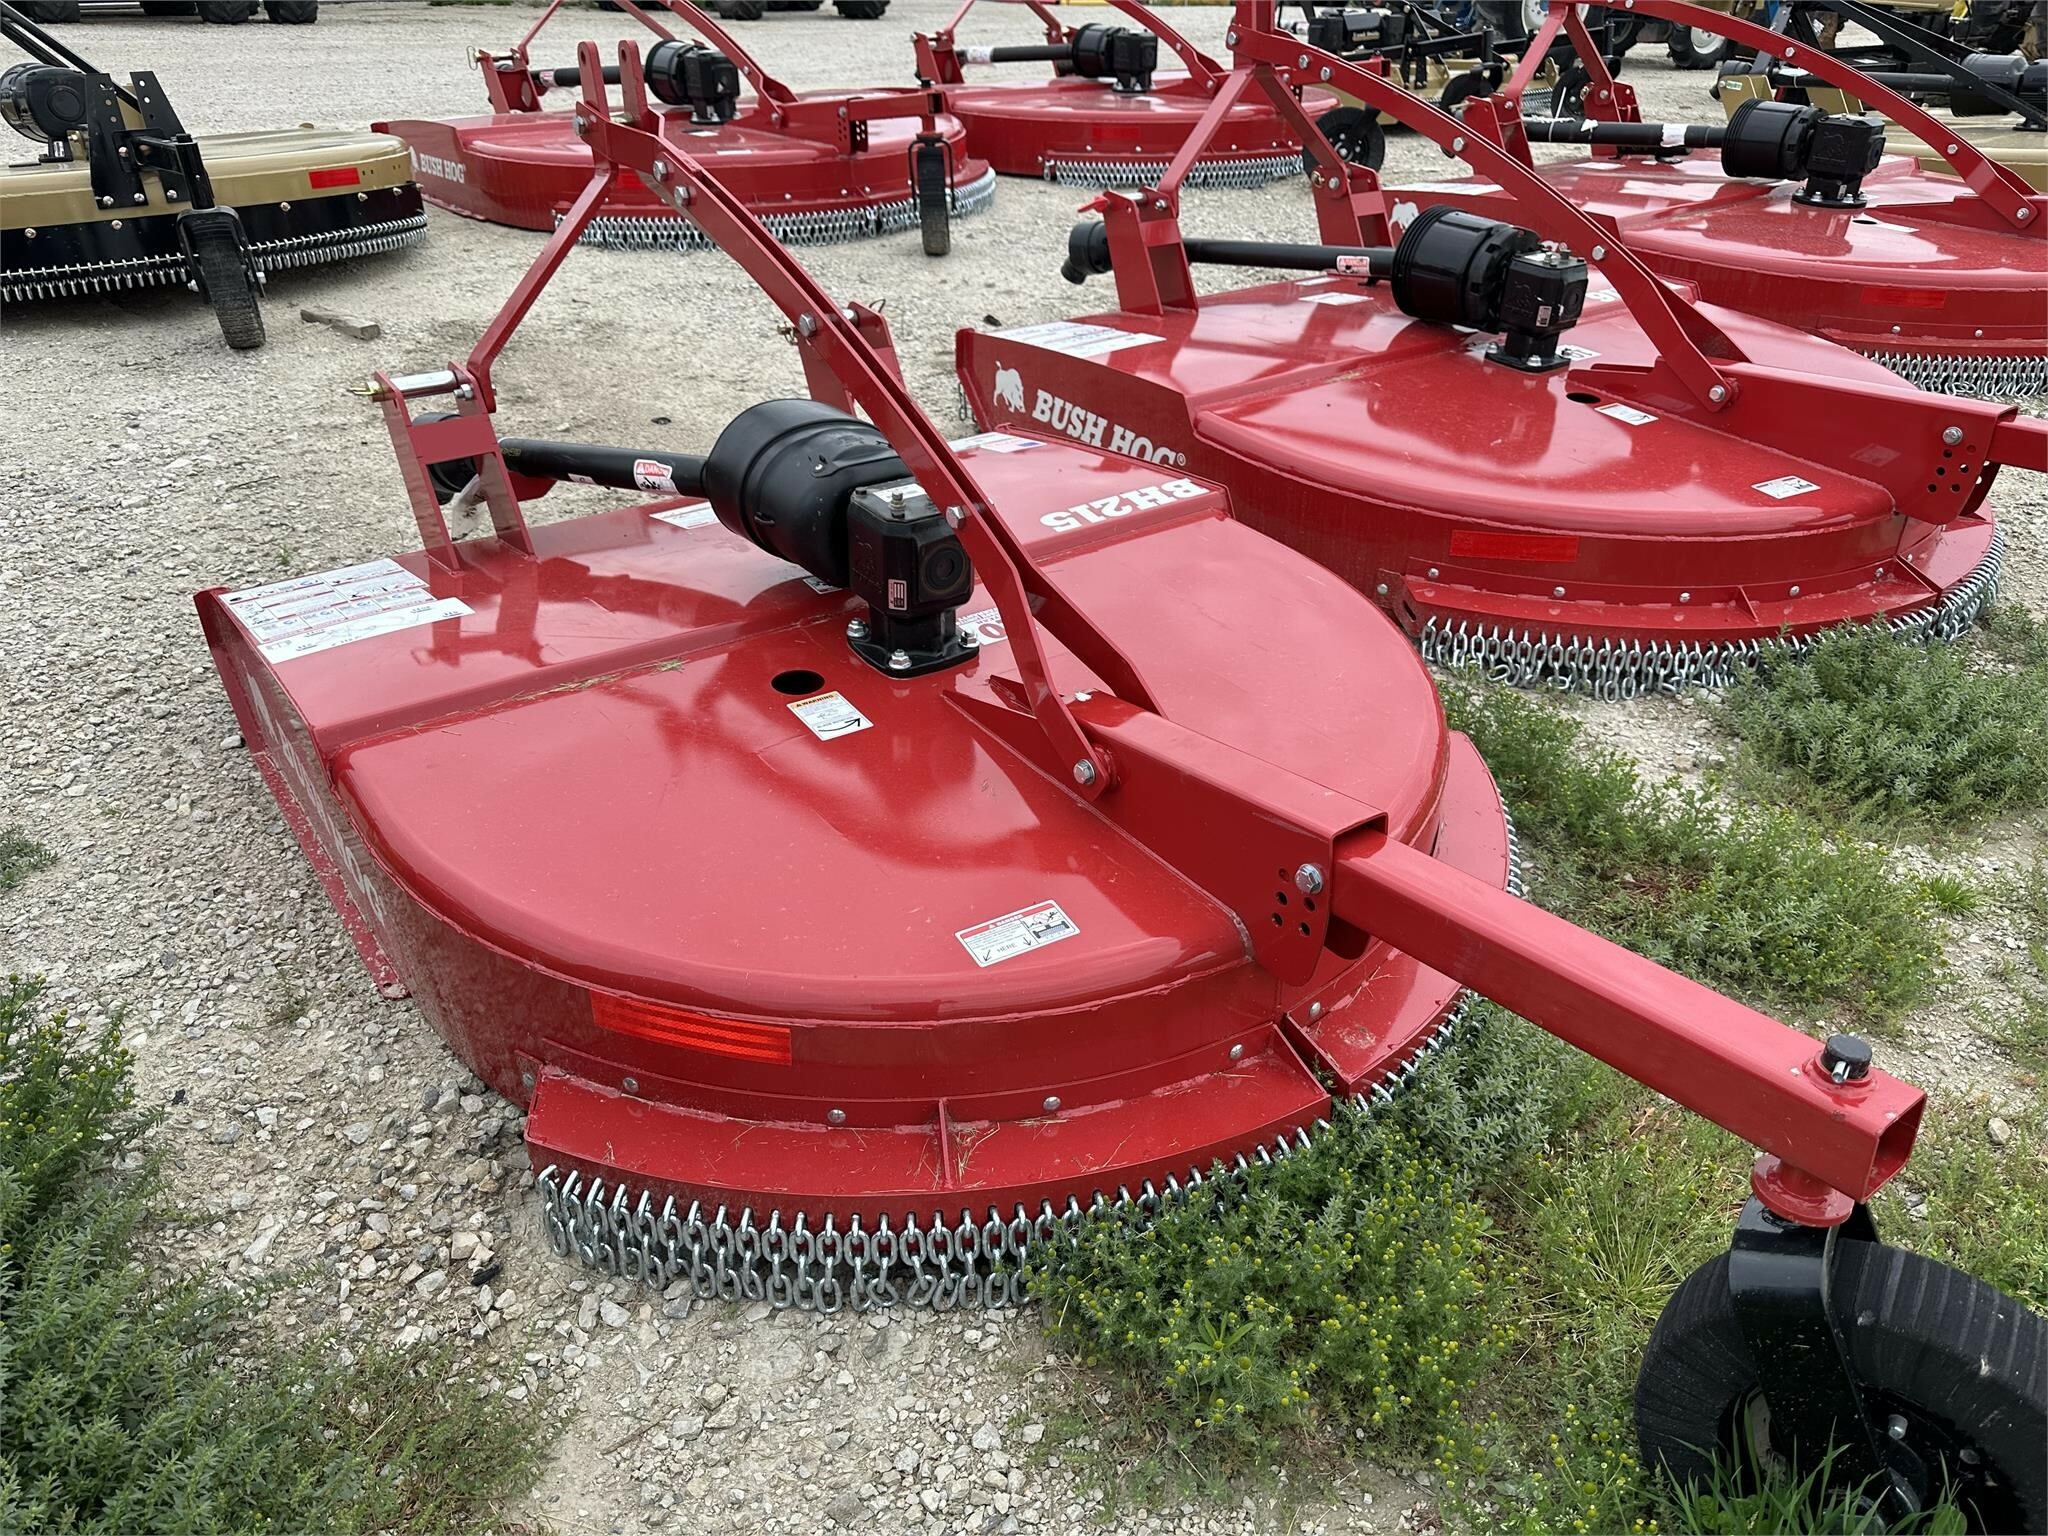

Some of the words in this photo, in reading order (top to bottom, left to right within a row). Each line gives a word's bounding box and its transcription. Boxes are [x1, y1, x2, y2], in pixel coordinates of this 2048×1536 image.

[419, 153, 443, 178] BUSH
[1032, 389, 1107, 445] BUSH
[1040, 477, 1210, 533] BH215
